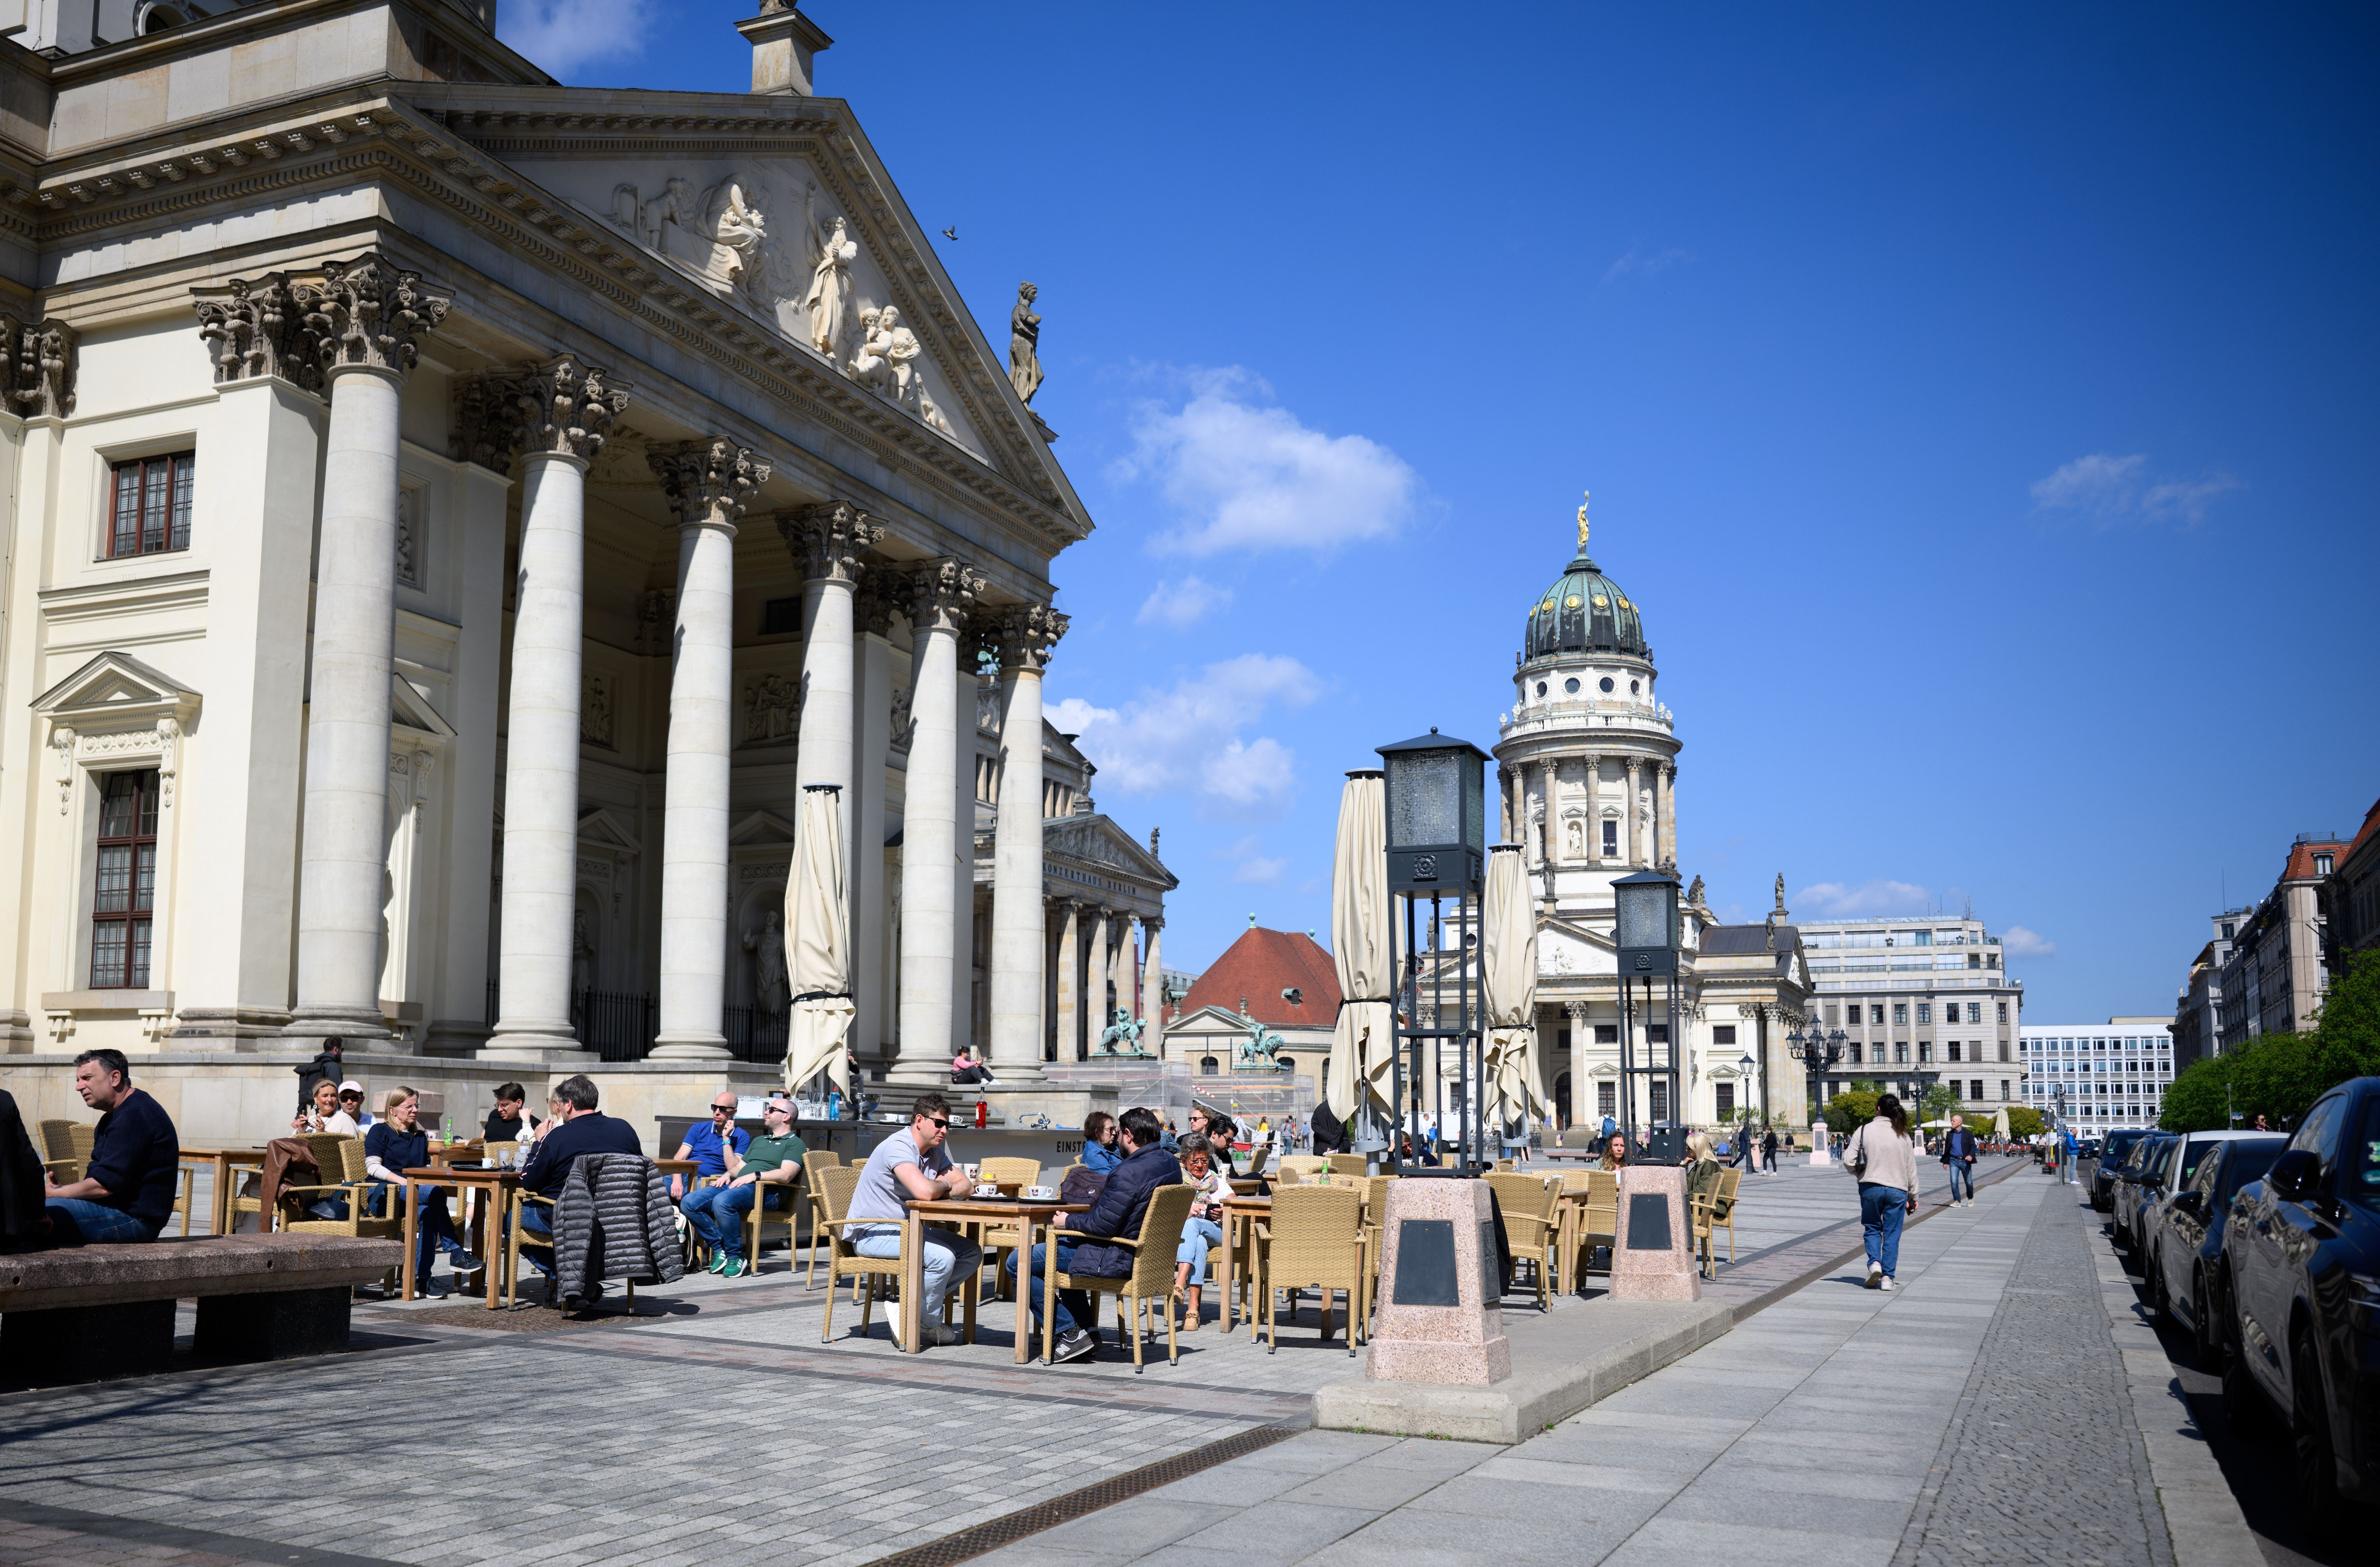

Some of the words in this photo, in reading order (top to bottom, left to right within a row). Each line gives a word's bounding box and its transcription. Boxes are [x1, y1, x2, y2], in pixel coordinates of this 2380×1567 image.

[1043, 862, 1102, 886] KONZERTHAUS
[1108, 881, 1136, 895] BERLIN
[1056, 1344, 1070, 1356] N
